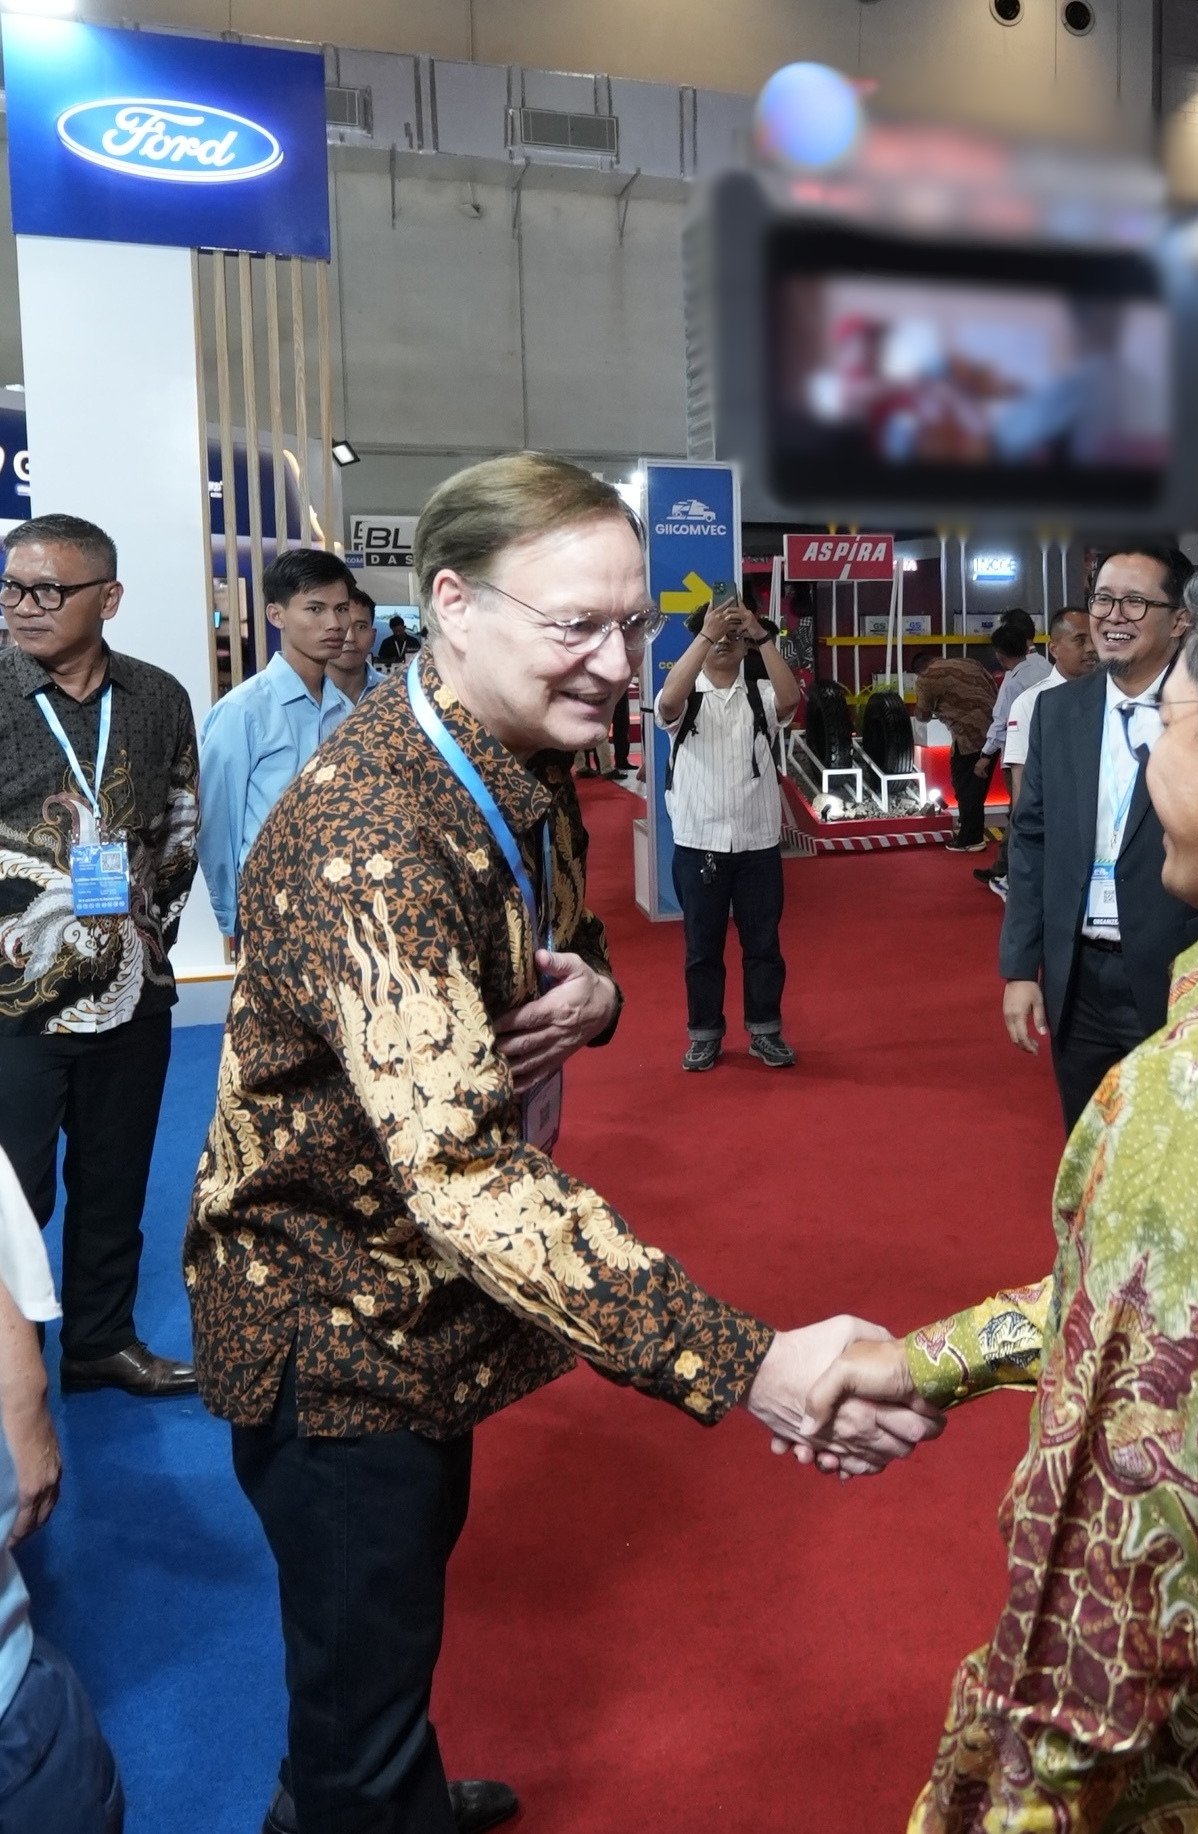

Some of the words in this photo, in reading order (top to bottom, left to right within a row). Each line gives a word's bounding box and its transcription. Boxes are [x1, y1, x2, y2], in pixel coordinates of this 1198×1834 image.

[102, 107, 238, 167] Ford
[365, 527, 411, 549] BL
[655, 523, 727, 536] GIICOMVEC
[370, 554, 414, 565] DAS
[802, 541, 887, 562] ASPIRA
